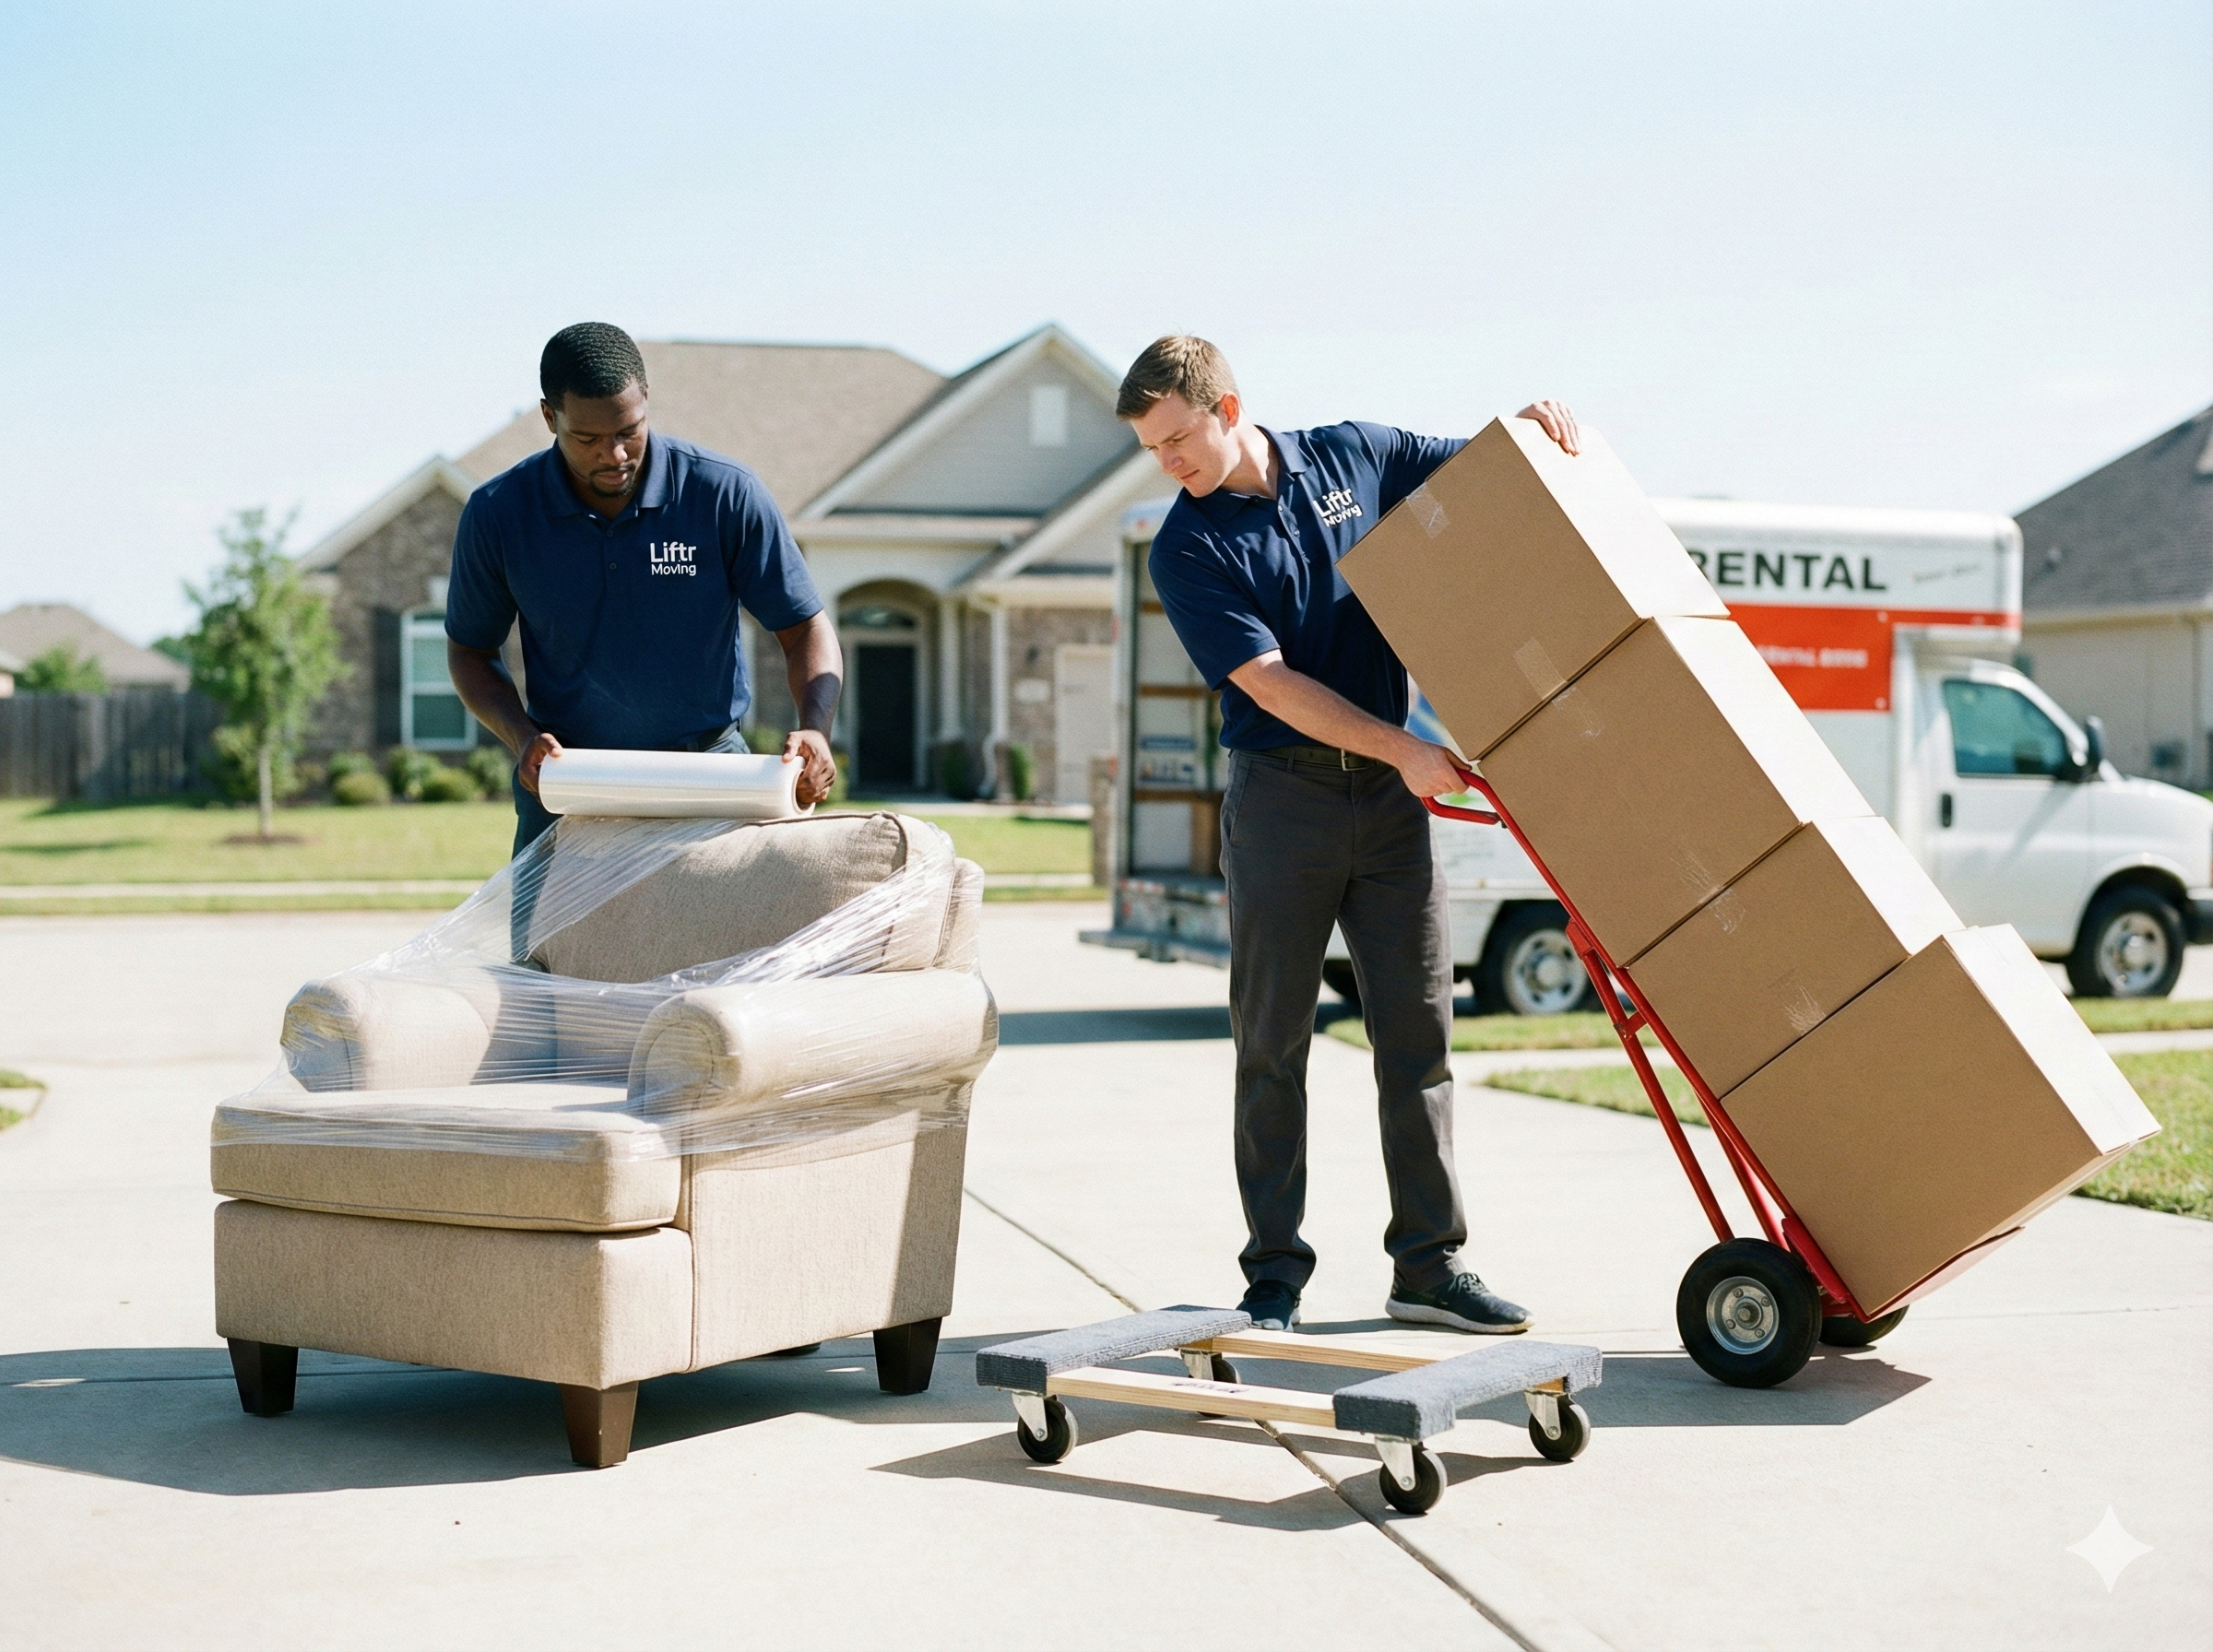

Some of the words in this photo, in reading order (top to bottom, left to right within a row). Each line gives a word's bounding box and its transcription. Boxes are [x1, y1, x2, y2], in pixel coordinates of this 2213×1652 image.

[1312, 488, 1353, 518] Liftr
[650, 541, 697, 562] Liftr
[651, 563, 697, 576] Moving
